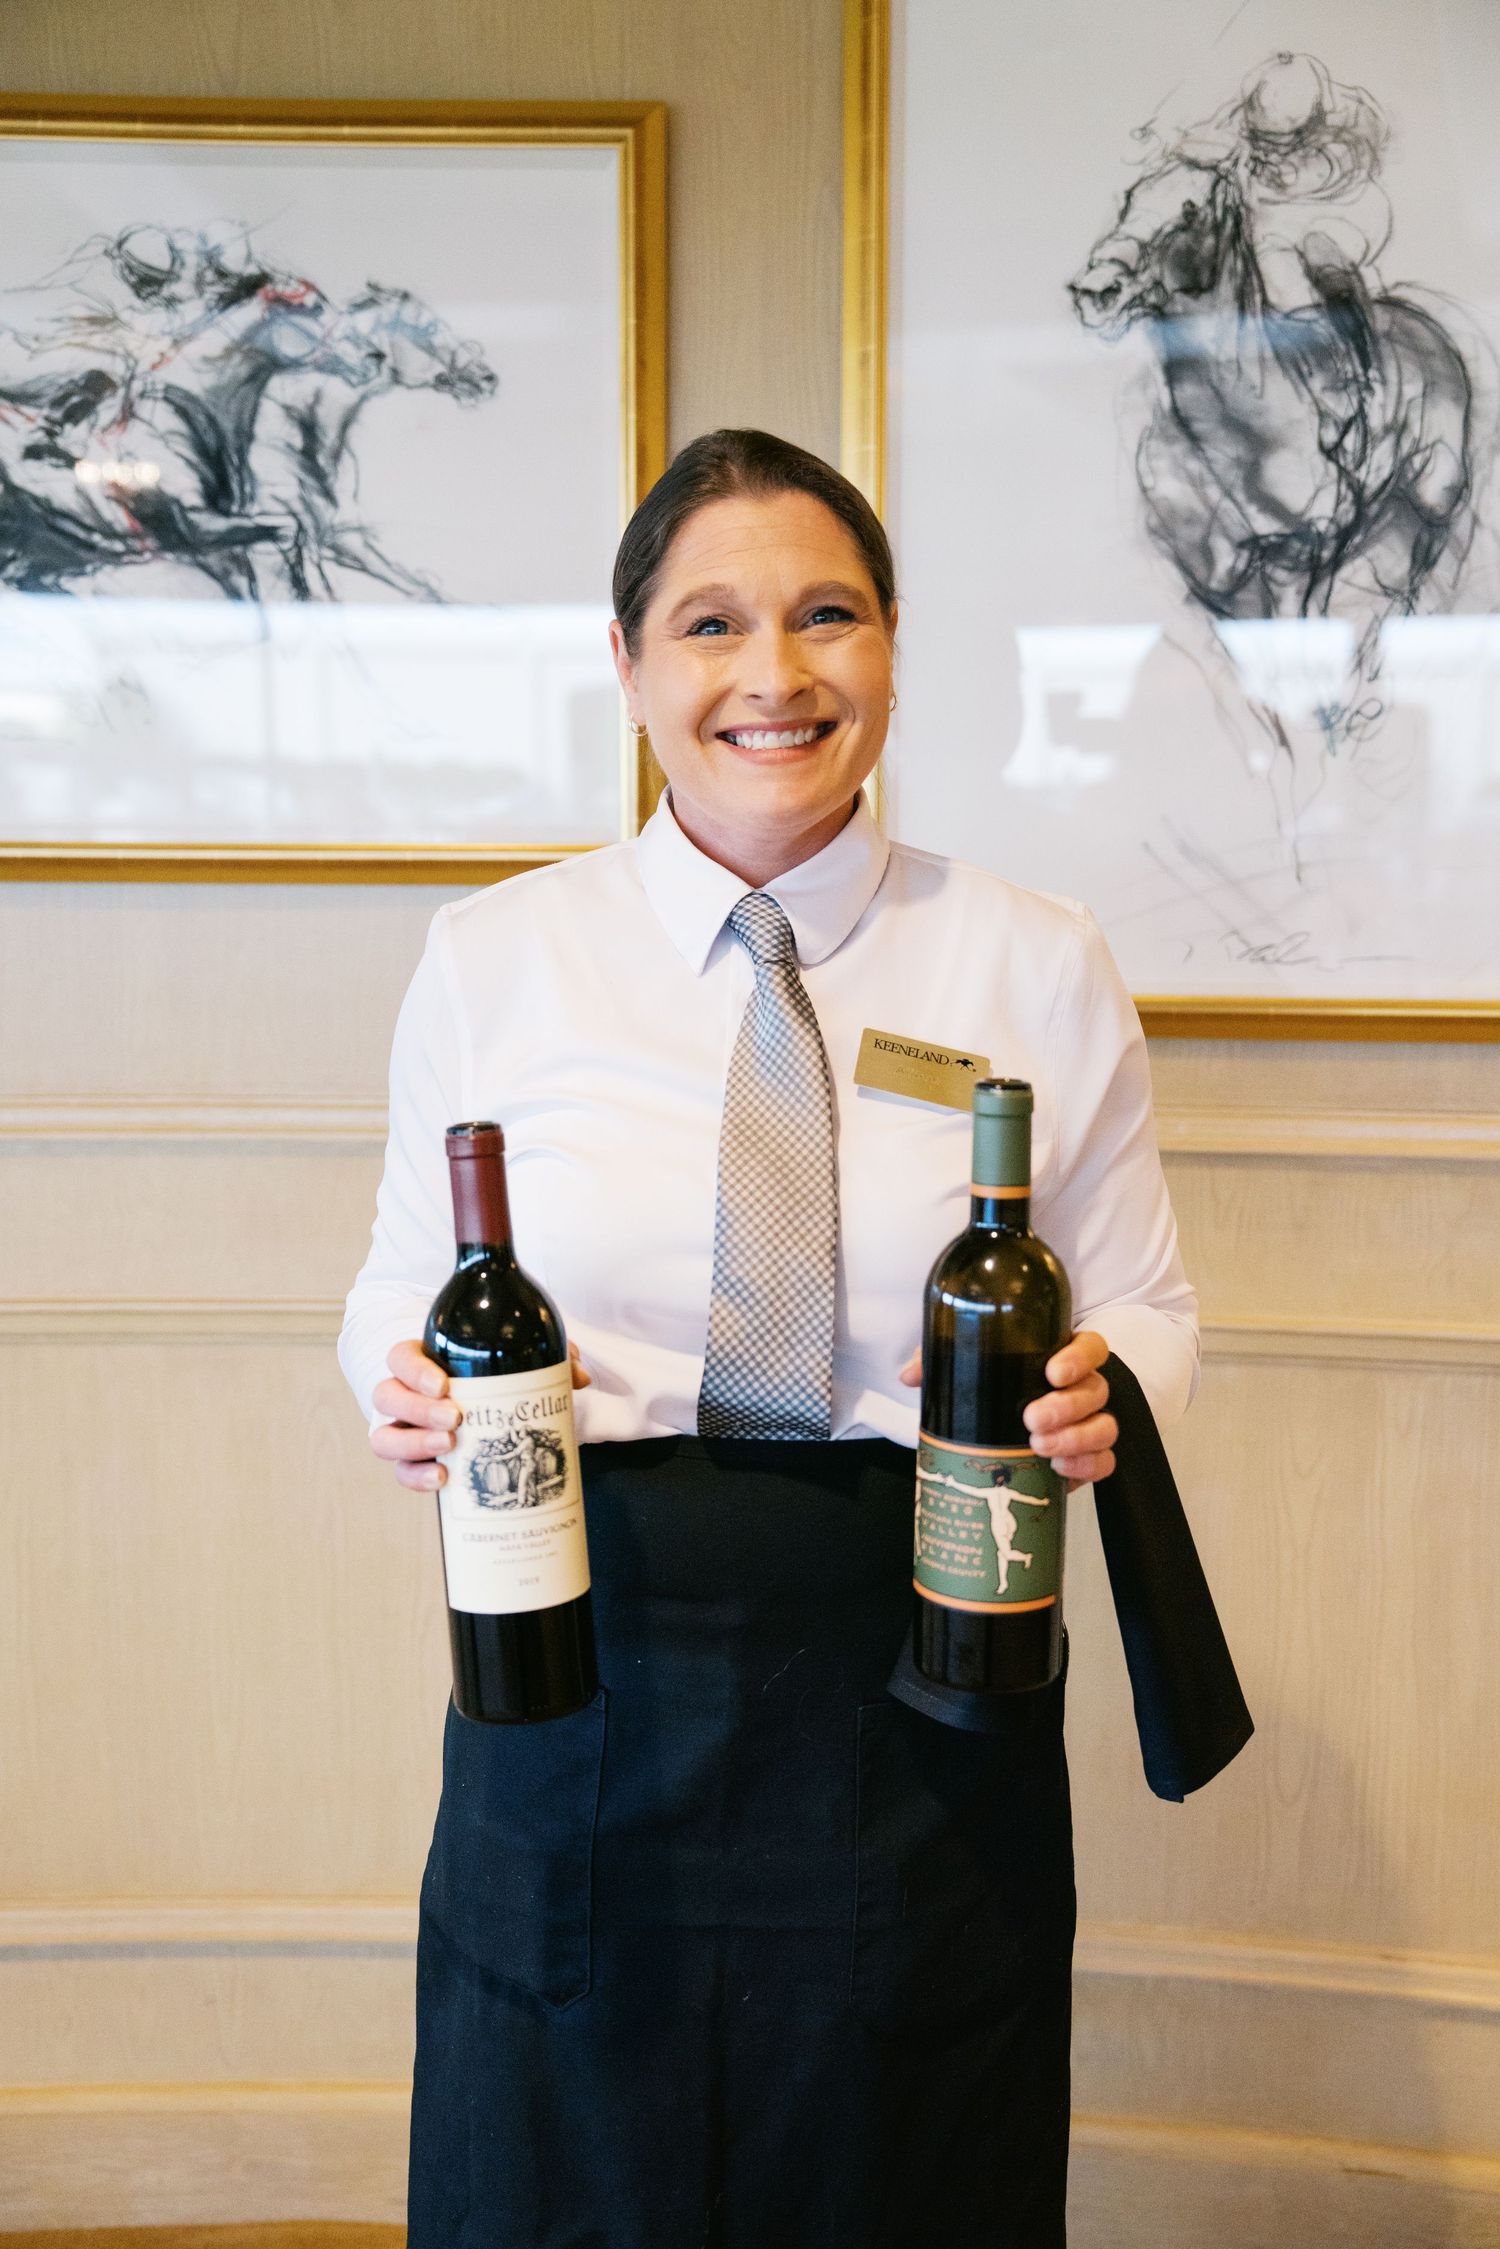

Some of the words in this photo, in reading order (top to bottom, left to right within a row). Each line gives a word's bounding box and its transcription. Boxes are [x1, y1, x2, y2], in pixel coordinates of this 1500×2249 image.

[874, 1039, 949, 1065] KEENELAND
[466, 1406, 504, 1429] eitz
[515, 1394, 569, 1422] Cellar
[462, 1532, 516, 1543] CABERNET
[521, 1518, 577, 1538] SAUVIGNON
